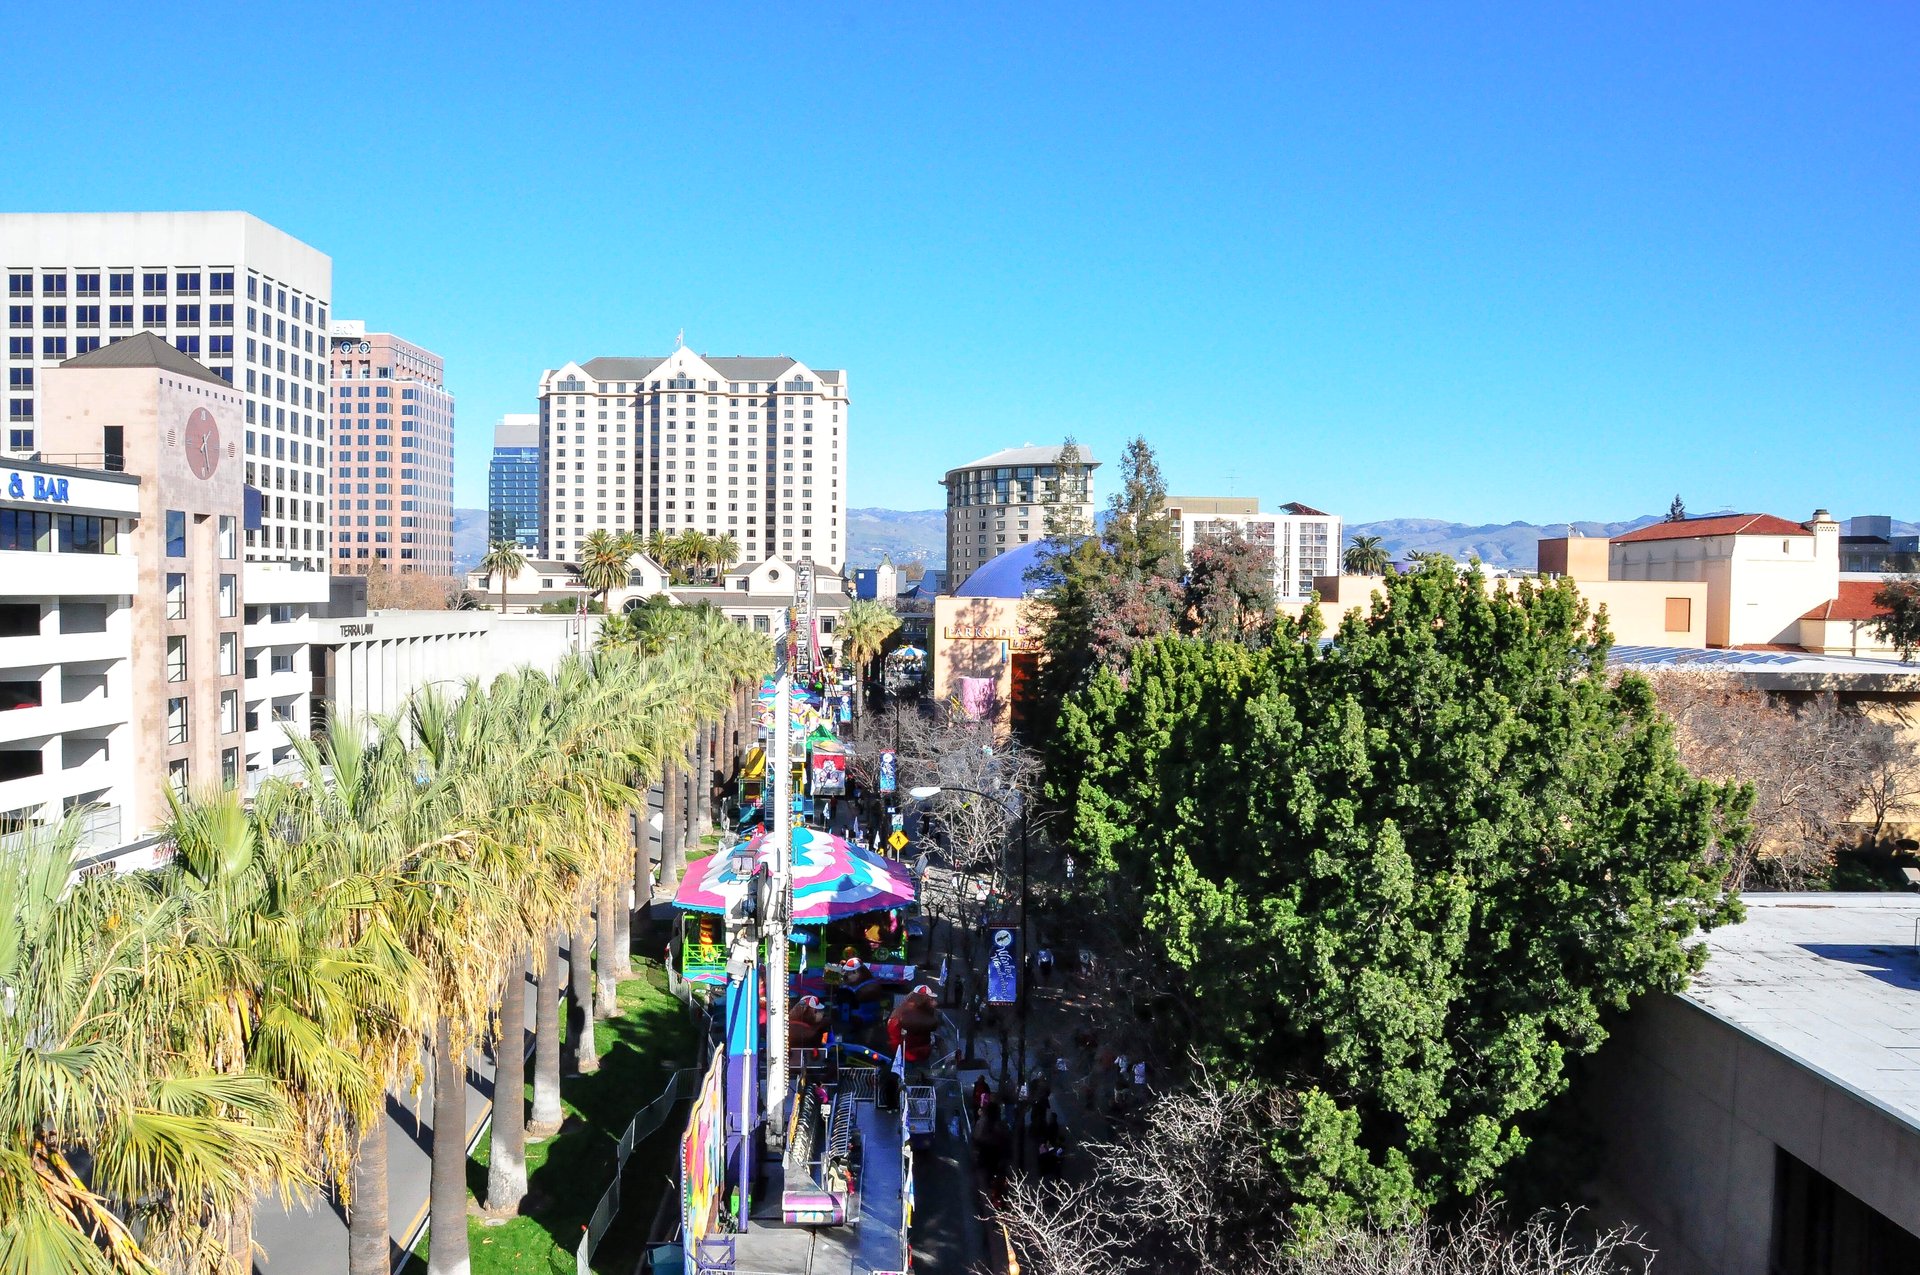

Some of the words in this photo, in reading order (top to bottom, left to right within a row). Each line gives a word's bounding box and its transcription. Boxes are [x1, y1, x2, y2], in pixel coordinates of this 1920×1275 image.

[9, 472, 25, 499] &
[33, 475, 69, 503] BAR
[340, 624, 360, 637] TERRA
[361, 623, 374, 636] LAW
[948, 626, 1015, 638] PARKSIDE
[995, 946, 1015, 978] Winter
